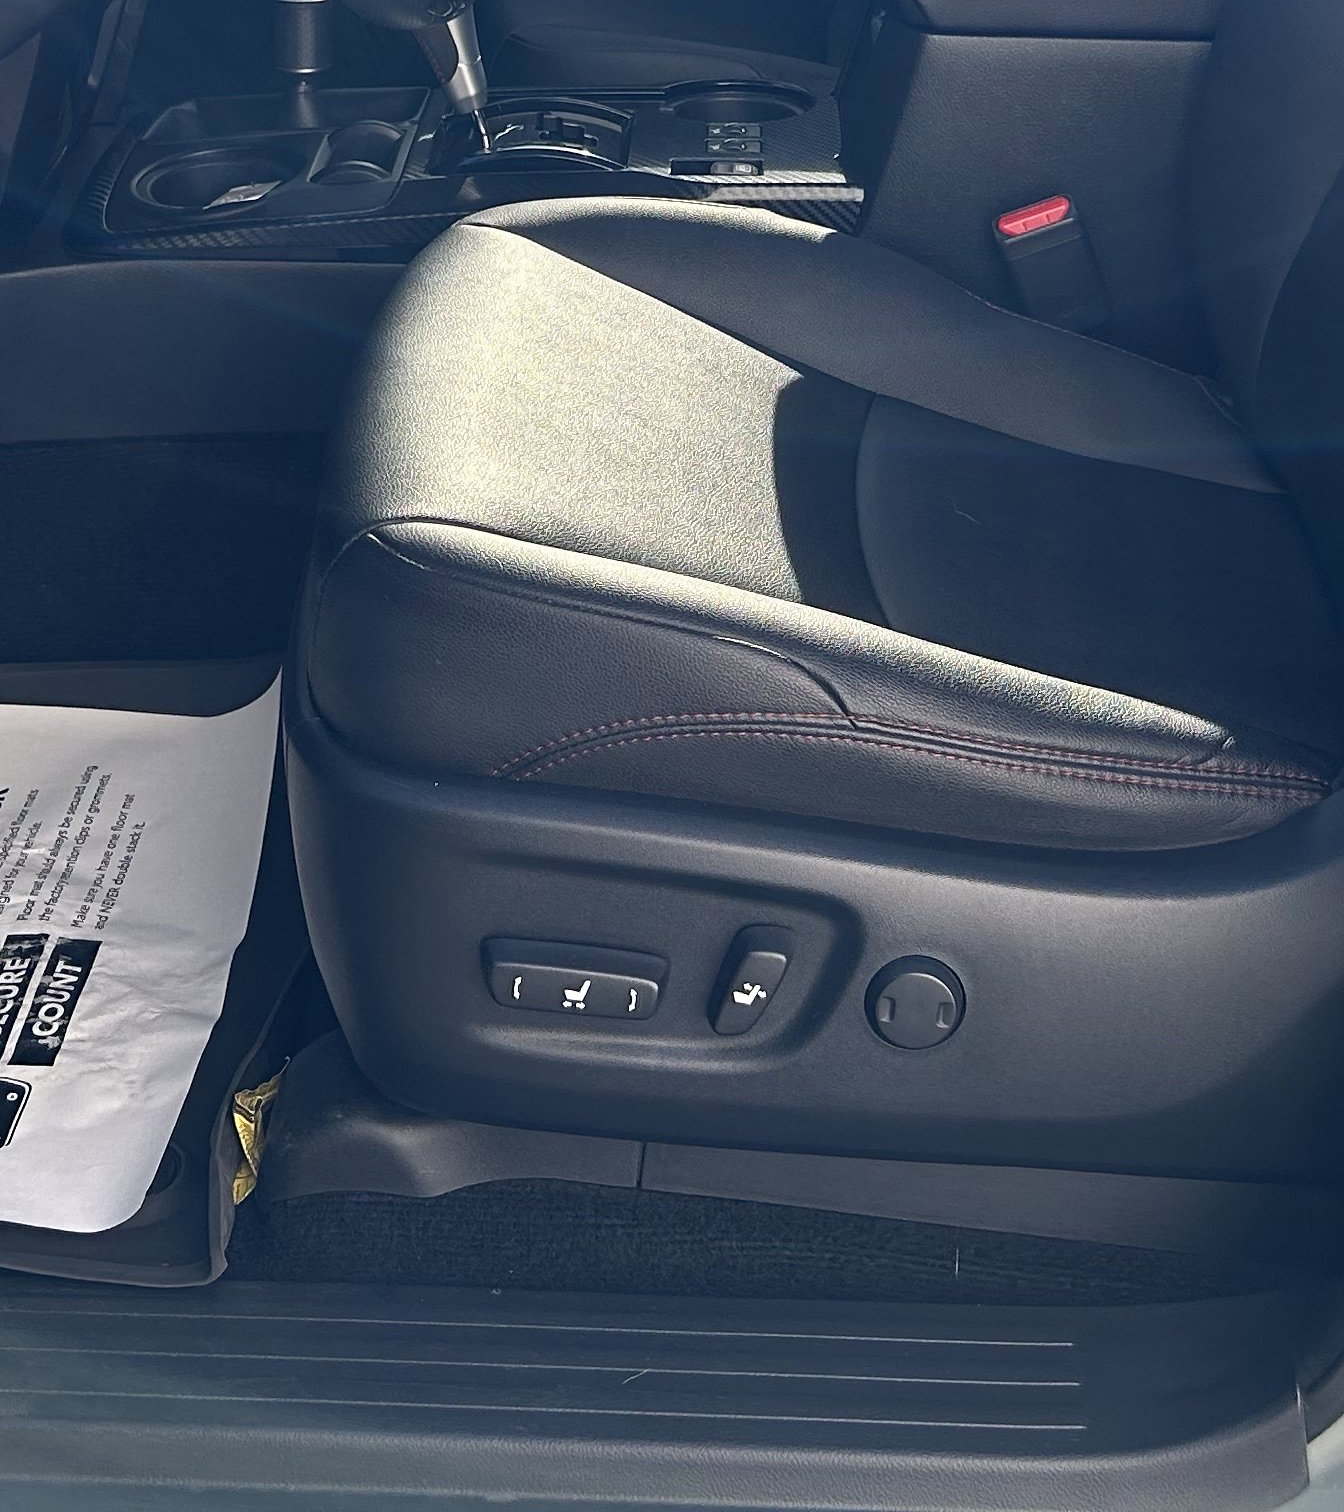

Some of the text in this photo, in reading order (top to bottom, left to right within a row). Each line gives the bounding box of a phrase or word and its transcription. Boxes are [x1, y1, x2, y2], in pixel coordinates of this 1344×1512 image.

[58, 817, 73, 828] be
[70, 905, 90, 928] Make
[96, 850, 113, 871] have
[111, 811, 128, 831] floor
[112, 855, 133, 885] double
[38, 907, 54, 921] the
[31, 958, 81, 1035] COUNT
